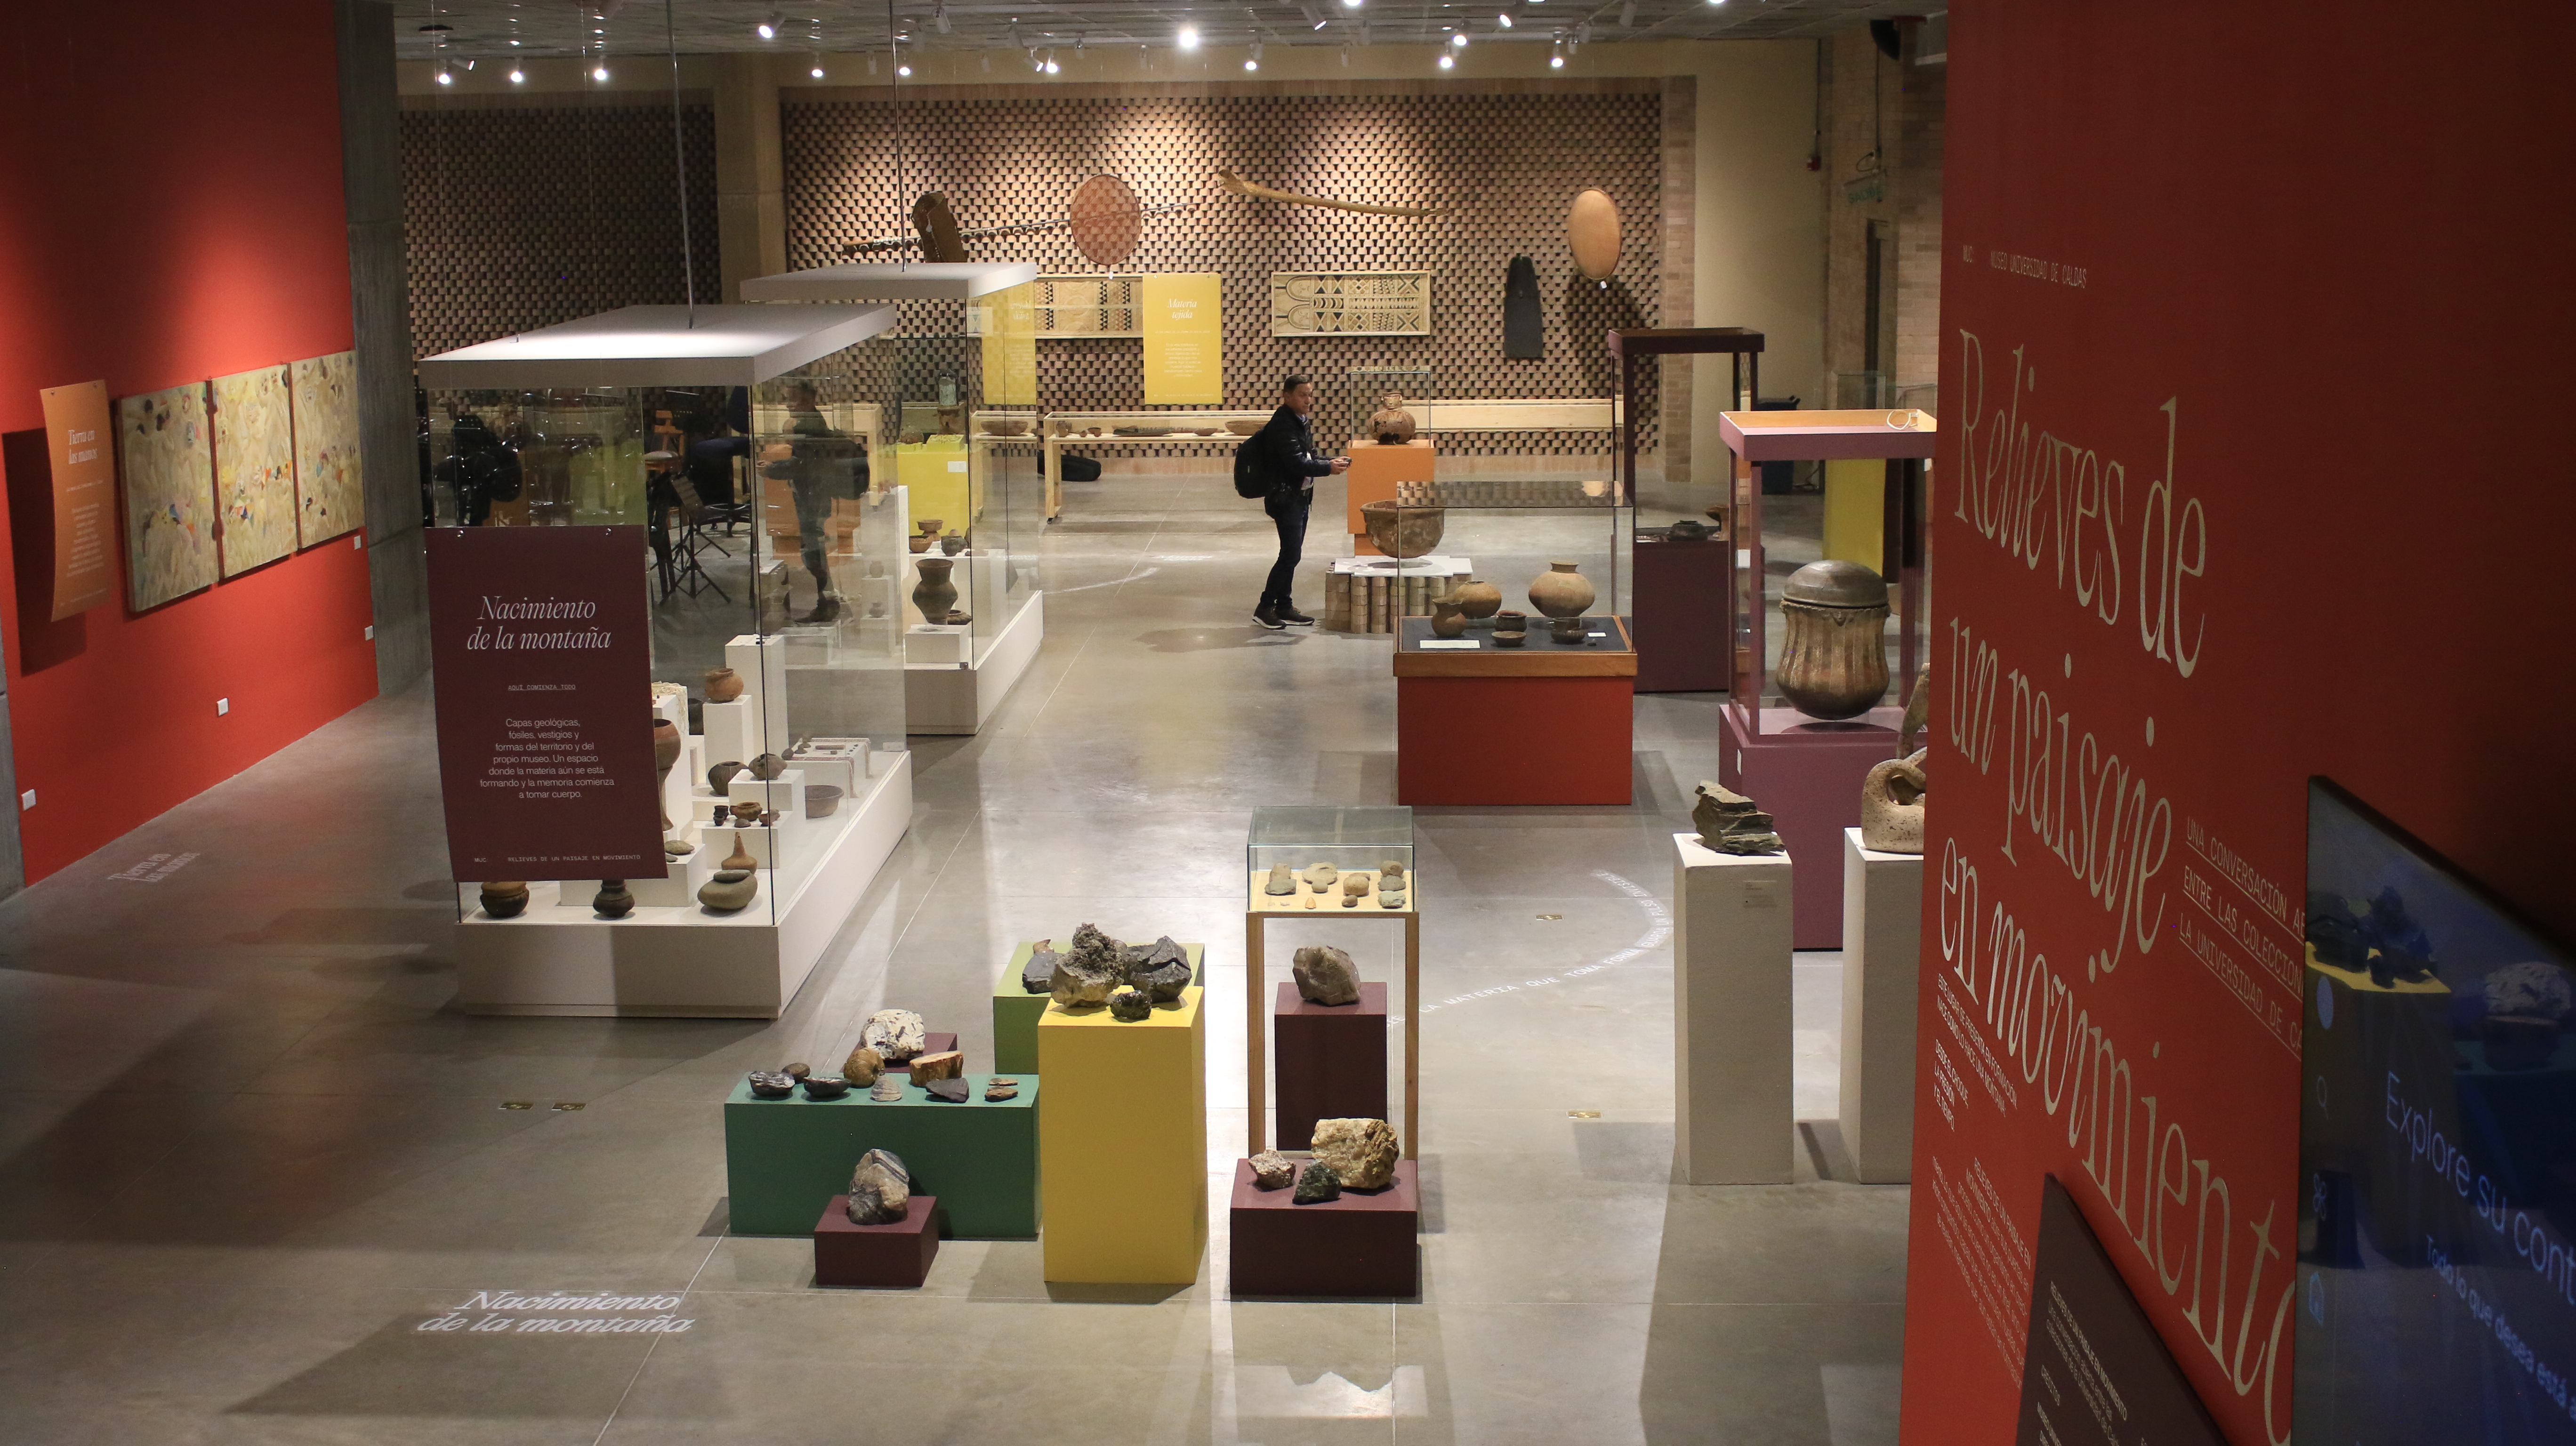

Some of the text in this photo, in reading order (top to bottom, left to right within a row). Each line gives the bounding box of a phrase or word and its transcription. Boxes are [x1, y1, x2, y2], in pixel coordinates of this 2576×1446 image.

[2010, 254, 2047, 279] UNIVERSIDAD
[2051, 263, 2058, 282] DE
[2062, 265, 2086, 289] CALDAS
[1167, 298, 1197, 308] Materia
[1955, 329, 2206, 678] Relieves de
[477, 596, 595, 619] Nacimiento
[467, 626, 611, 650] de la montaña
[526, 683, 559, 691] COMIENZA
[560, 683, 576, 691] TODO
[506, 719, 532, 728] Capas
[538, 731, 572, 740] vestigios
[493, 755, 519, 764] propio
[567, 755, 598, 763] espacio
[1950, 617, 2171, 973] un paisaje
[2188, 817, 2286, 921] UNA CONVERSACIÓN
[2184, 865, 2212, 911] ENTRE
[2218, 896, 2237, 933] LAS
[1654, 916, 1670, 926] UN
[1941, 838, 1979, 1005] en
[1641, 926, 1670, 948] GUARDA
[1603, 947, 1644, 965] FORMA
[1564, 964, 1604, 978] TOMA
[2181, 913, 2283, 1034] LA UNIVERSIDAD DE
[1525, 977, 1560, 987] QUE
[1443, 984, 1520, 1005] MATERIA
[1419, 1003, 1441, 1013] LA
[2387, 1071, 2470, 1198] Explore
[2477, 1174, 2505, 1237] su
[454, 1291, 680, 1310] Nacimiento
[2426, 1234, 2454, 1284] Todo
[2456, 1265, 2467, 1299] lo
[2469, 1289, 2493, 1327] que
[2495, 1314, 2535, 1374] desea
[417, 1312, 696, 1333] de la montaña
